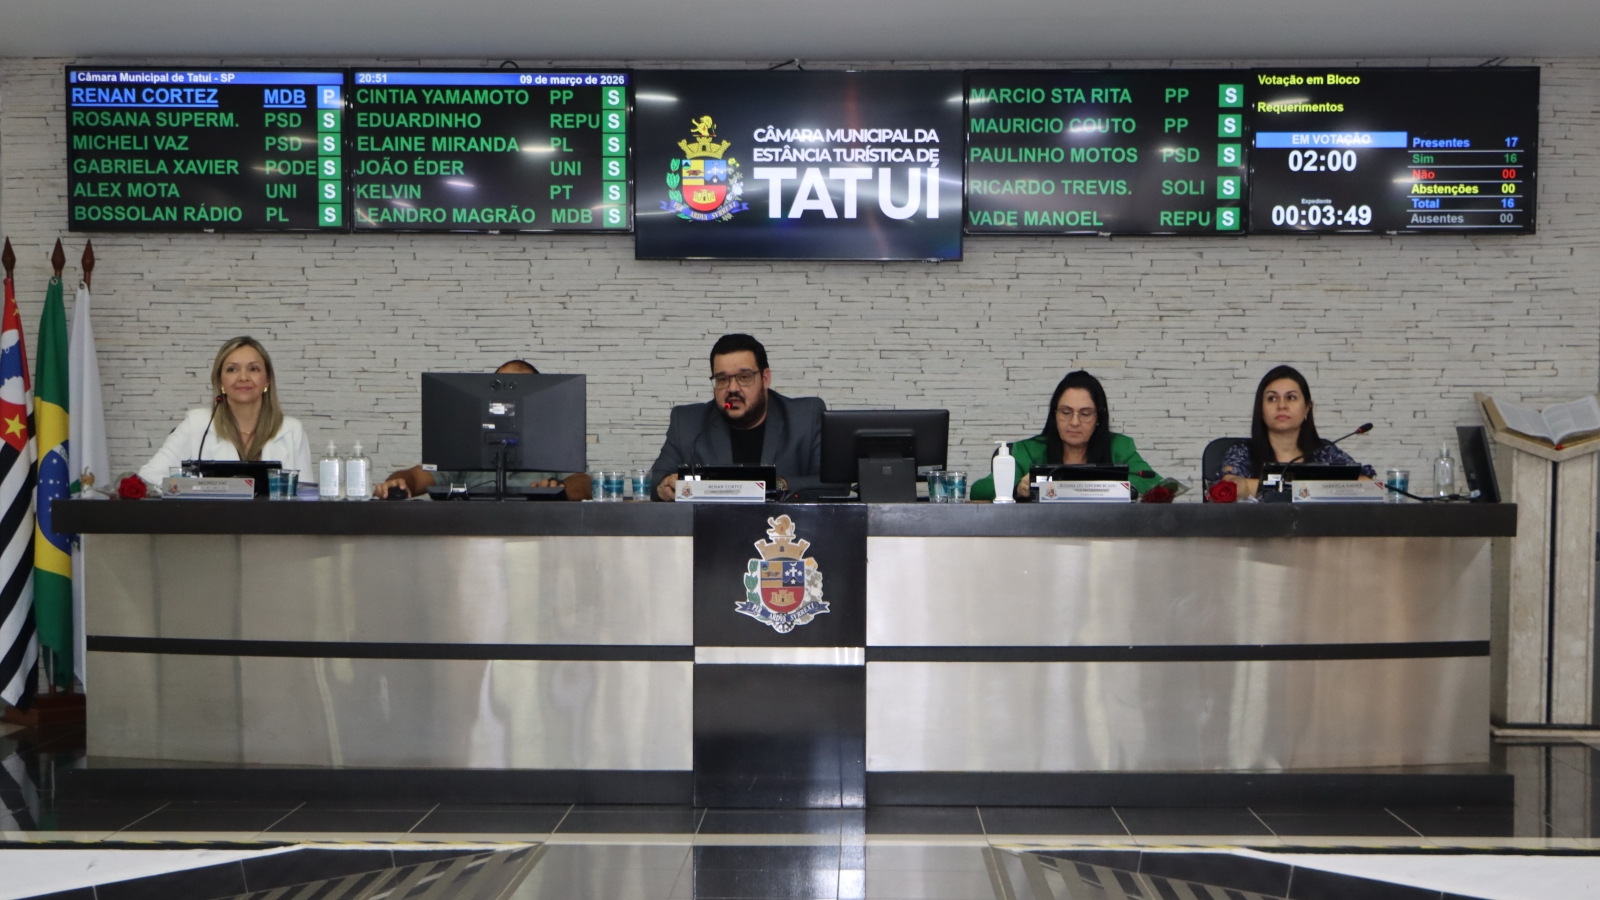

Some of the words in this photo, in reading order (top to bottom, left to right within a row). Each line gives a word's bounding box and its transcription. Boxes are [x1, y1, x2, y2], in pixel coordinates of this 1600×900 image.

[78, 72, 117, 82] Câmara
[119, 72, 169, 83] Municipal
[171, 73, 184, 82] de
[220, 74, 235, 82] SP
[359, 74, 387, 83] 20:51
[520, 75, 532, 84] 09
[535, 75, 547, 84] de
[550, 76, 582, 86] março
[585, 76, 597, 85] de
[600, 75, 624, 85] 2026
[1258, 75, 1304, 86] Votação
[1327, 75, 1360, 85] Bloco
[72, 88, 136, 103] RENAN
[142, 89, 218, 104] CORTEZ
[264, 90, 306, 104] MDB
[323, 90, 335, 103] P
[356, 90, 418, 104] CINTIA
[422, 90, 529, 104] YAMAMOTO
[550, 91, 574, 104] PP
[608, 90, 620, 105] S
[971, 89, 1045, 103] MARCIO
[1051, 89, 1086, 103] STA
[1091, 89, 1132, 103] RITA
[1165, 89, 1189, 103] PP
[1225, 89, 1237, 103] S
[1258, 102, 1344, 114] Requerimentos
[72, 112, 151, 126] ROSANA
[156, 112, 239, 128] SUPERM.
[265, 114, 301, 128] PSD
[323, 114, 335, 128] S
[357, 113, 481, 128] EDUARDINHO
[550, 114, 600, 128] REPU
[608, 114, 620, 128] S
[971, 118, 1063, 133] MAURICIO
[1070, 119, 1136, 133] COUTO
[1165, 119, 1188, 133] PP
[1224, 118, 1236, 133] S
[753, 125, 824, 143] CÂMARA
[826, 129, 913, 143] MUNICIPAL
[915, 129, 939, 143] DA
[1292, 135, 1310, 144] EM
[1313, 132, 1371, 146] VOTAÇÃO
[73, 136, 148, 150] MICHELI
[154, 136, 188, 150] VAZ
[265, 137, 301, 151] PSD
[323, 137, 335, 152] S
[358, 137, 425, 151] ELAINE
[432, 137, 519, 152] MIRANDA
[551, 138, 573, 152] PL
[608, 138, 620, 152] S
[1413, 138, 1470, 148] Presentes
[1505, 138, 1518, 147] 17
[753, 145, 831, 162] ESTÂNCIA
[833, 145, 915, 162] TURÍSTICA
[917, 148, 939, 162] DE
[971, 148, 1064, 163] PAULINHO
[1071, 148, 1138, 163] MOTOS
[1163, 148, 1200, 162] PSD
[1223, 148, 1235, 163] S
[1288, 150, 1357, 172] 02:00
[1413, 154, 1434, 163] Sim
[1504, 154, 1517, 163] 16
[74, 159, 168, 174] GABRIELA
[174, 160, 238, 174] XAVIER
[266, 161, 316, 175] PODE
[324, 161, 335, 175] S
[356, 158, 407, 175] JOÃO
[414, 157, 464, 175] ÉDER
[551, 161, 581, 176] UNI
[608, 161, 620, 176] S
[1412, 170, 1435, 179] Não
[1502, 169, 1516, 179] 00
[74, 182, 122, 197] ALEX
[128, 183, 180, 198] MOTA
[266, 184, 296, 199] UNI
[324, 185, 336, 199] S
[356, 185, 421, 199] KELVIN
[550, 186, 573, 199] PT
[608, 186, 620, 200] S
[754, 162, 939, 219] TATUÍ
[970, 180, 1055, 195] RICARDO
[1061, 180, 1132, 195] TREVIS.
[1162, 180, 1204, 195] SOLI
[1223, 180, 1235, 195] S
[1412, 184, 1478, 195] Abstenções
[1502, 184, 1515, 193] 00
[1412, 198, 1440, 208] Total
[1501, 198, 1515, 208] 16
[75, 206, 177, 221] BOSSOLAN
[184, 204, 242, 222] RÁDIO
[266, 207, 289, 222] PL
[324, 208, 336, 222] S
[356, 208, 446, 223] LEANDRO
[453, 206, 535, 223] MAGRÃO
[552, 209, 592, 223] MDB
[608, 209, 620, 223] S
[969, 212, 1017, 226] VADE
[1024, 211, 1103, 226] MANOEL
[1160, 211, 1210, 226] REPU
[1222, 211, 1234, 226] S
[1272, 206, 1372, 226] 00:03:49
[1411, 214, 1464, 223] Ausentes
[1500, 213, 1513, 223] 00
